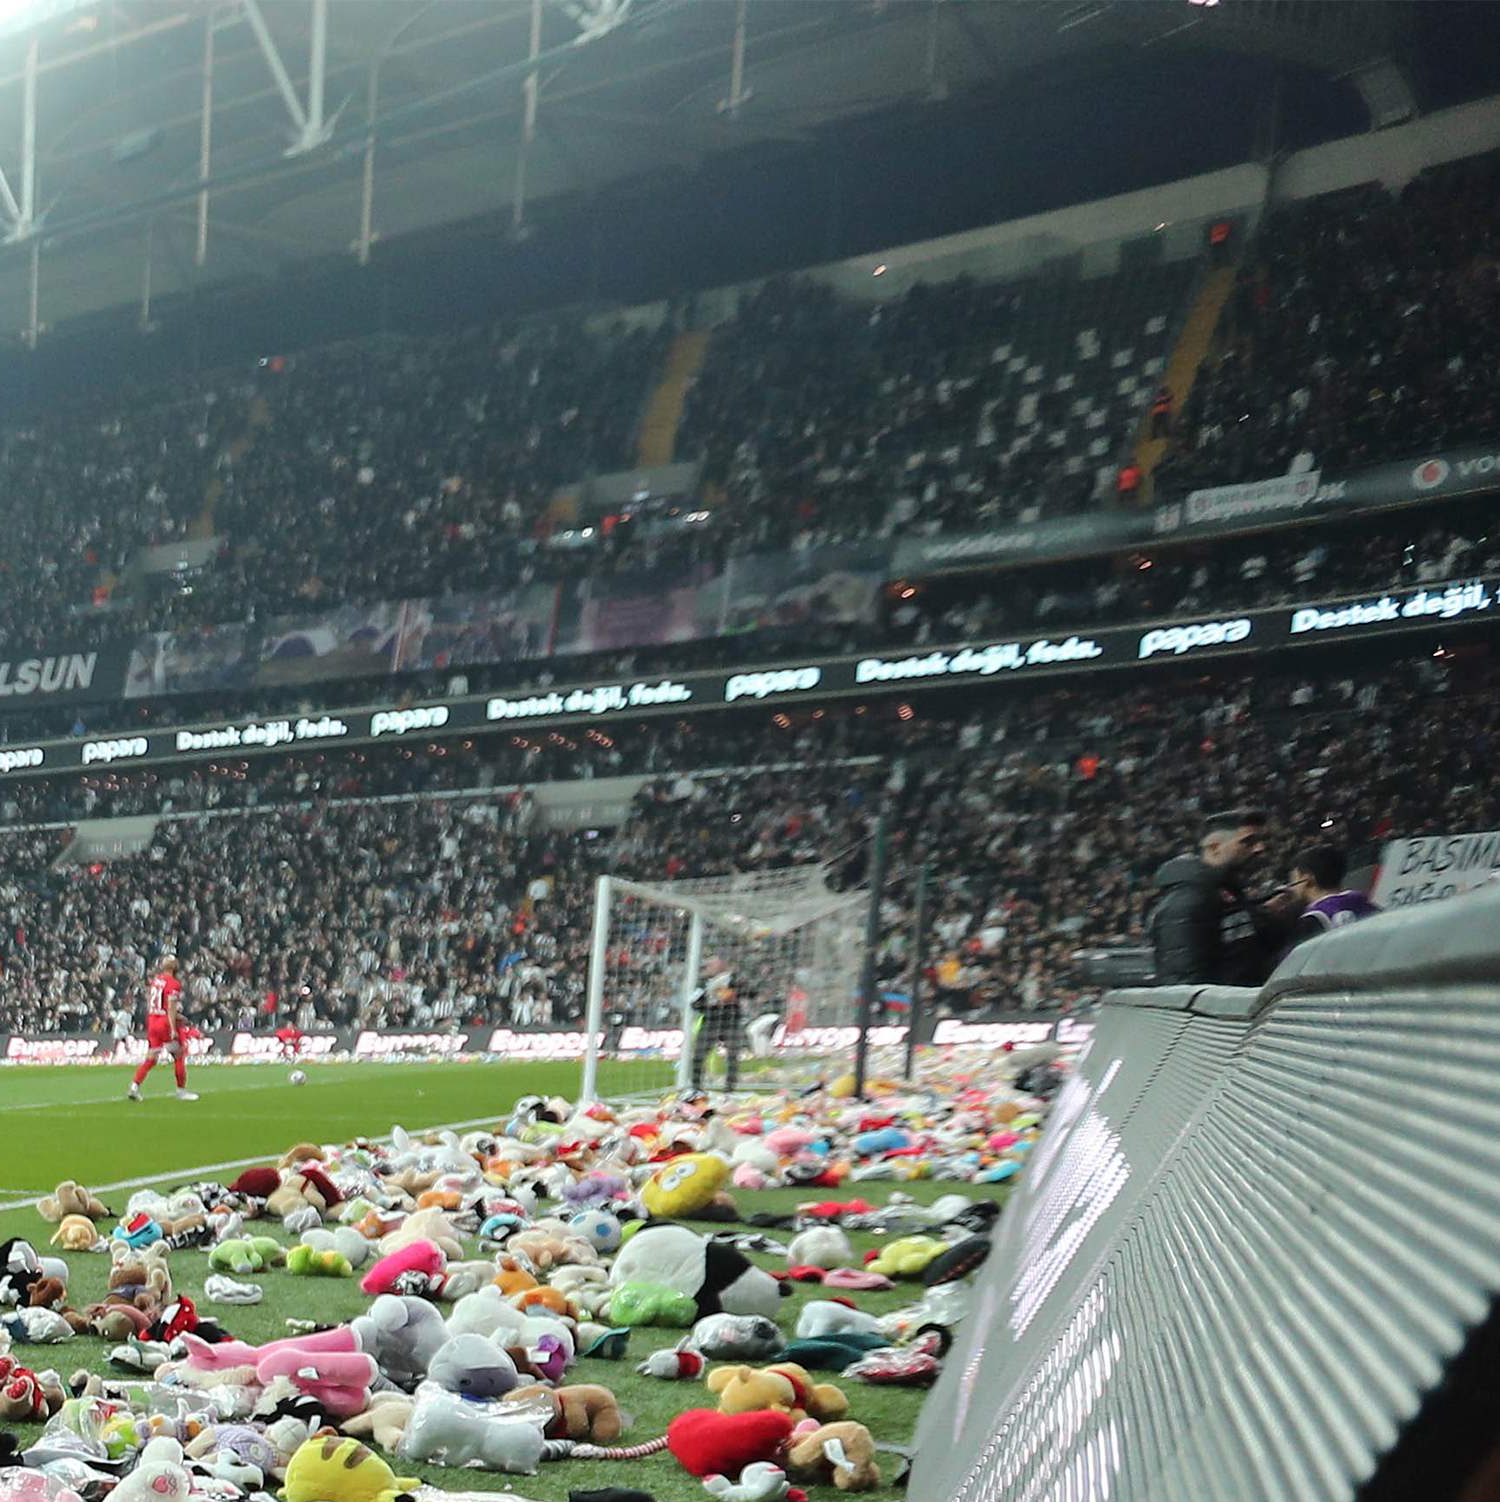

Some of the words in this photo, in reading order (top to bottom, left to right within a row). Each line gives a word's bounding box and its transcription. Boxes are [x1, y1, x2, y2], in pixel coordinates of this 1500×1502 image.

[1291, 597, 1401, 633] Destek
[1402, 584, 1492, 618] değil,
[372, 706, 449, 736] papara
[83, 737, 148, 764] papara
[150, 986, 163, 1011] 21
